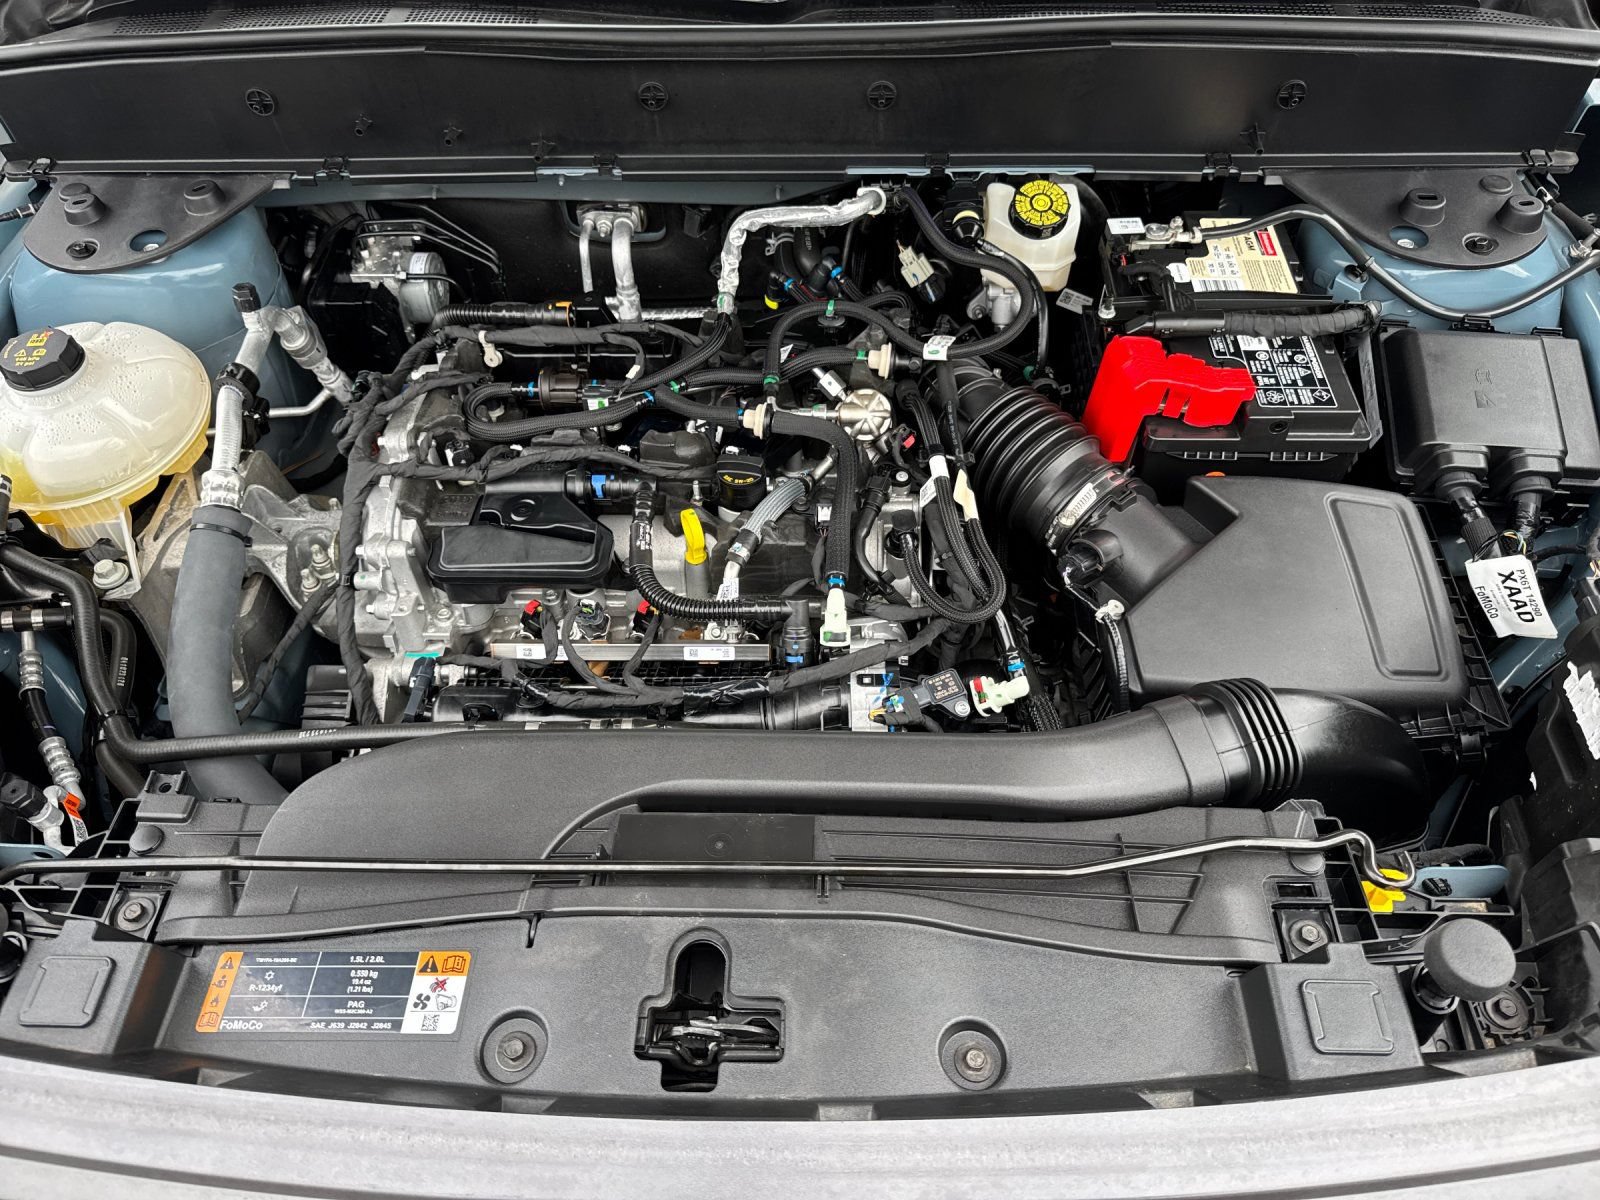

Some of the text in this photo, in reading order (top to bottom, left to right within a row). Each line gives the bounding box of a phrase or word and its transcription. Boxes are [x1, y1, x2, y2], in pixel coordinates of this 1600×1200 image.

[1244, 236, 1256, 251] AGM
[1497, 570, 1536, 623] XAAD
[1516, 568, 1543, 617] PX6T 14290
[1474, 585, 1499, 619] FoMoCo
[350, 955, 365, 963] 1.5L
[369, 955, 385, 963] 2.0L
[369, 969, 379, 979] kg
[248, 983, 283, 993] R-1234yf
[347, 986, 374, 994] (1.21 lbs)
[347, 1000, 365, 1008] PAG
[220, 1020, 264, 1030] FoMoCo
